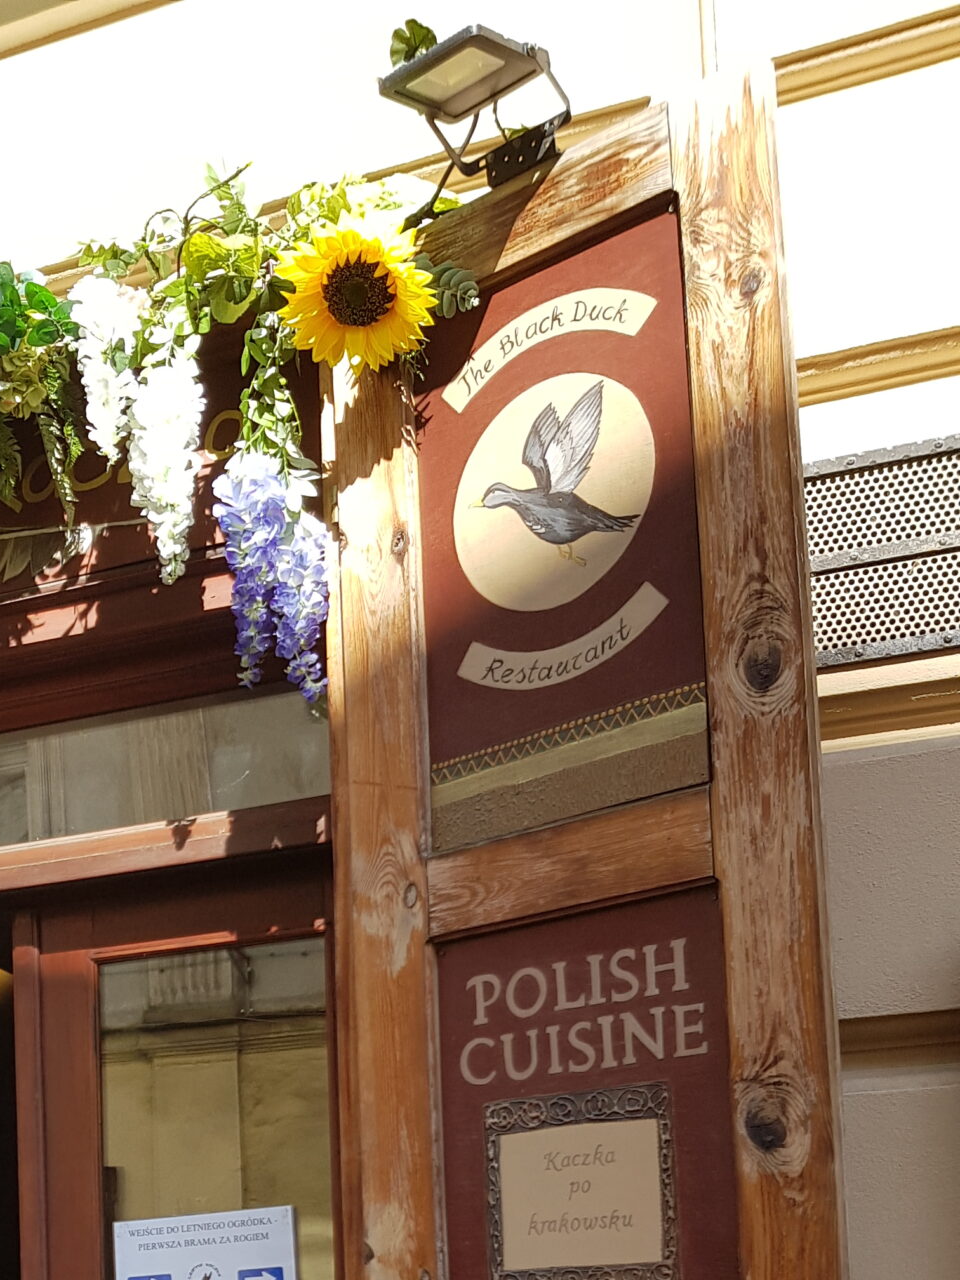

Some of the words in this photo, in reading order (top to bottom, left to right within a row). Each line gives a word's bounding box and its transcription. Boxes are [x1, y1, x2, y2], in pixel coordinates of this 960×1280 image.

[457, 364, 495, 396] The
[499, 309, 565, 359] Black
[571, 298, 629, 324] Duck
[480, 617, 631, 685] Restaurant
[465, 936, 691, 1027] POLISH
[459, 1002, 709, 1086] CUISINE
[543, 1143, 617, 1173] Kaczka
[568, 1178, 592, 1201] po
[128, 1226, 165, 1238] WEJŚCIE
[166, 1226, 180, 1235] DO
[181, 1221, 226, 1233] LETNIEGO
[227, 1216, 273, 1229] OGRÓDKA
[527, 1209, 634, 1236] krakowsku
[138, 1240, 182, 1252] PIERWSZA
[184, 1237, 218, 1248] BRAMA
[218, 1235, 232, 1244] ZA
[233, 1232, 270, 1242] ROGIEM
